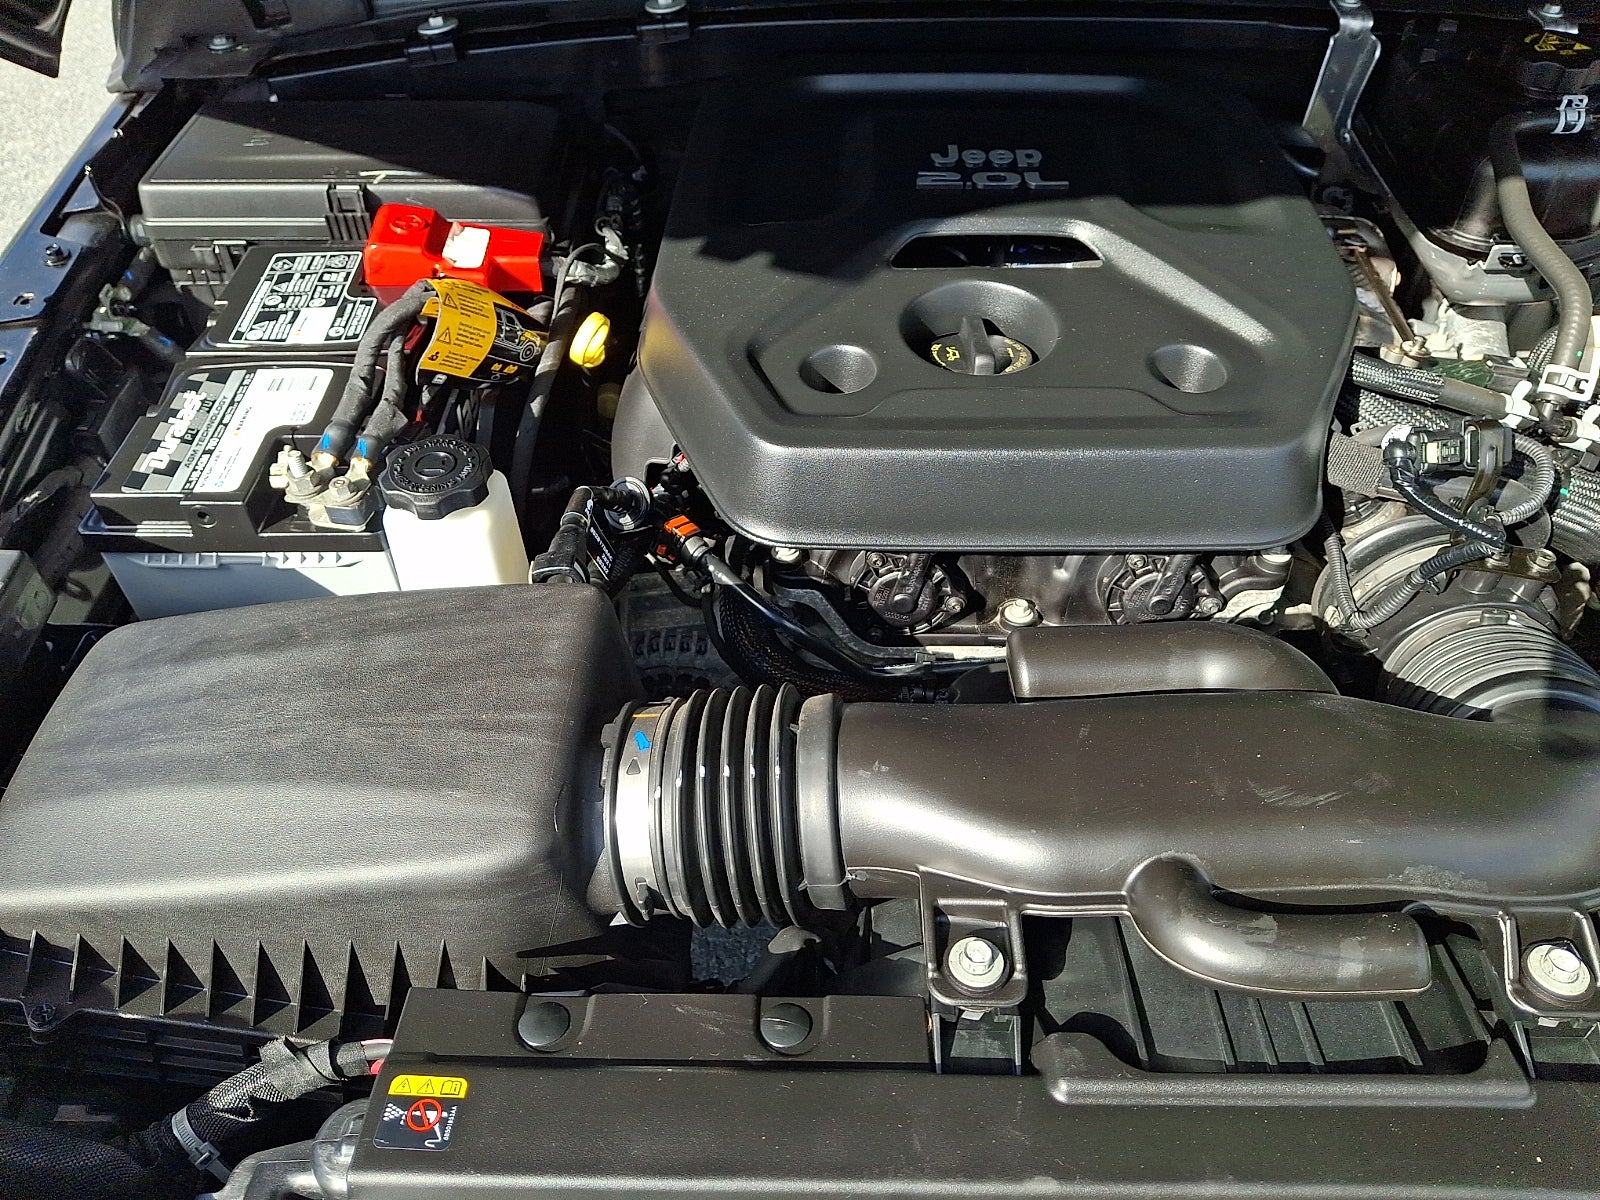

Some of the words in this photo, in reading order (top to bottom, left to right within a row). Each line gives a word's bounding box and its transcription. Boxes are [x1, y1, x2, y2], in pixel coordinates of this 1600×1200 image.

[915, 170, 1070, 190] 2.0L
[930, 144, 1043, 168] Jeep
[140, 389, 209, 470] Duralast
[184, 449, 199, 468] AGM
[197, 395, 229, 446] TECHNOLOGY
